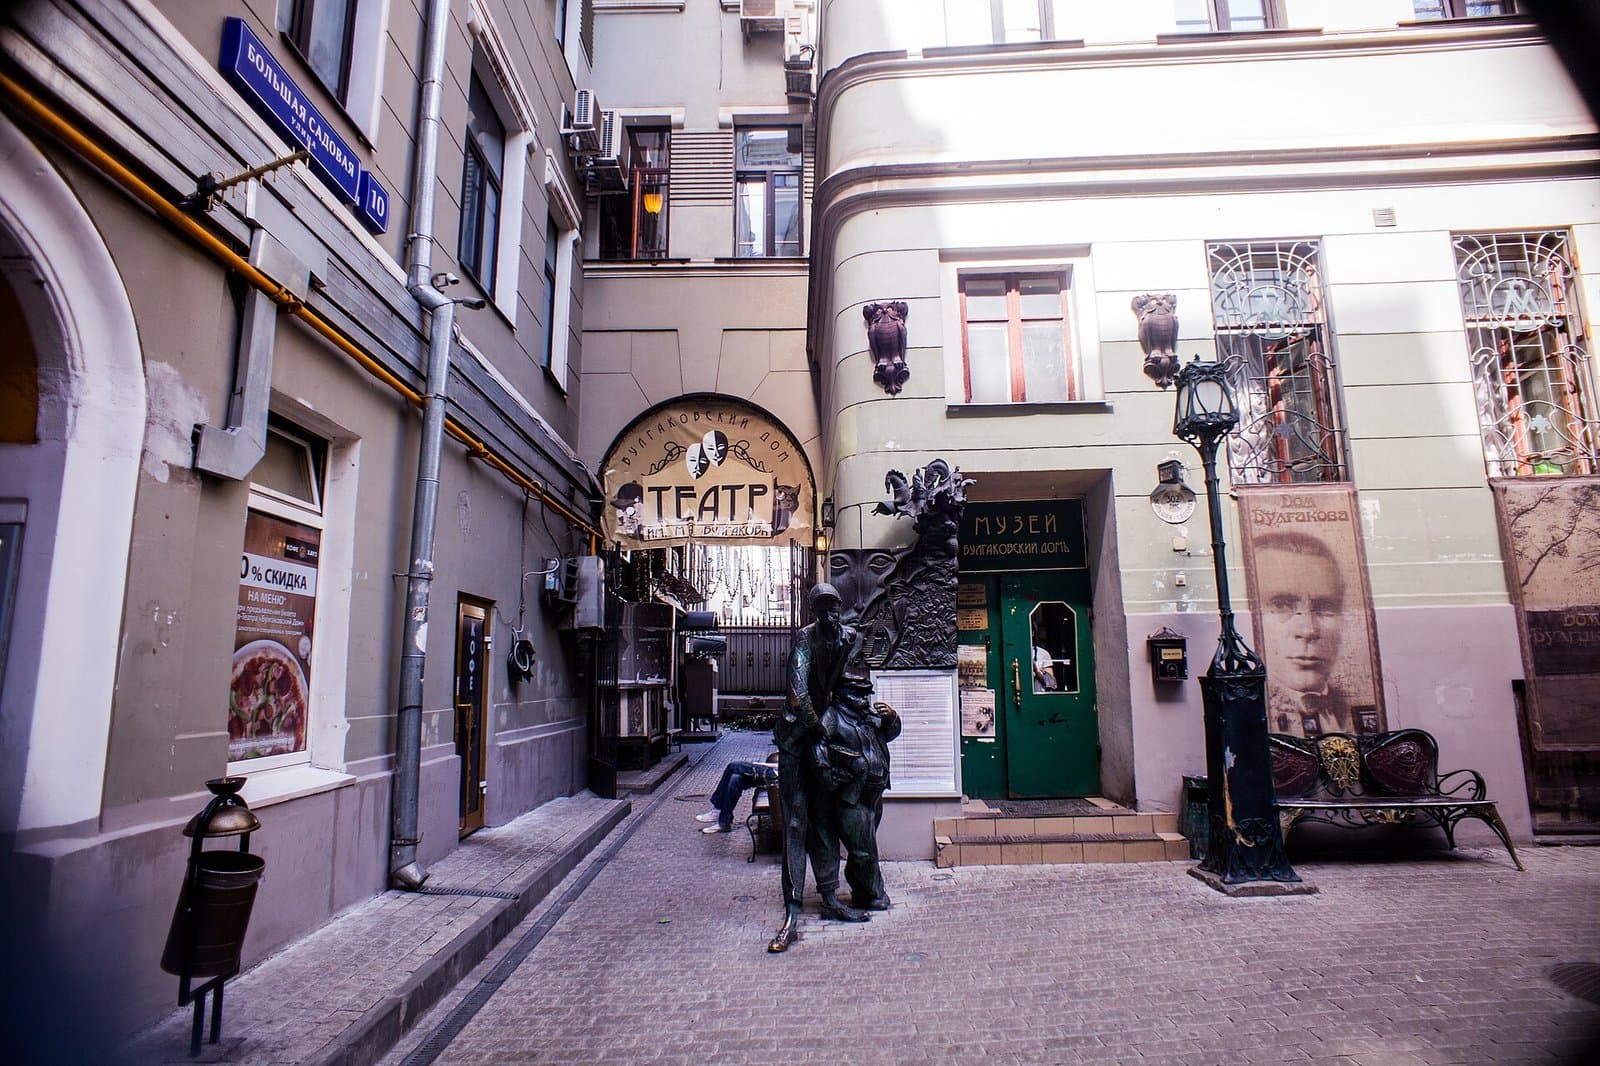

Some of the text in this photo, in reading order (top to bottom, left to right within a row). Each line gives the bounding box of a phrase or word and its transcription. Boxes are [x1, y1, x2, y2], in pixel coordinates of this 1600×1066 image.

[248, 42, 355, 178] БОЛЬШАЯ САДОВАЯ
[371, 189, 385, 218] 10
[760, 431, 789, 463] ДОМ
[648, 484, 768, 521] ТЕАТР
[975, 513, 1057, 535] МУЗЕЙ
[265, 568, 307, 590] СКИДКА
[248, 591, 259, 602] НА
